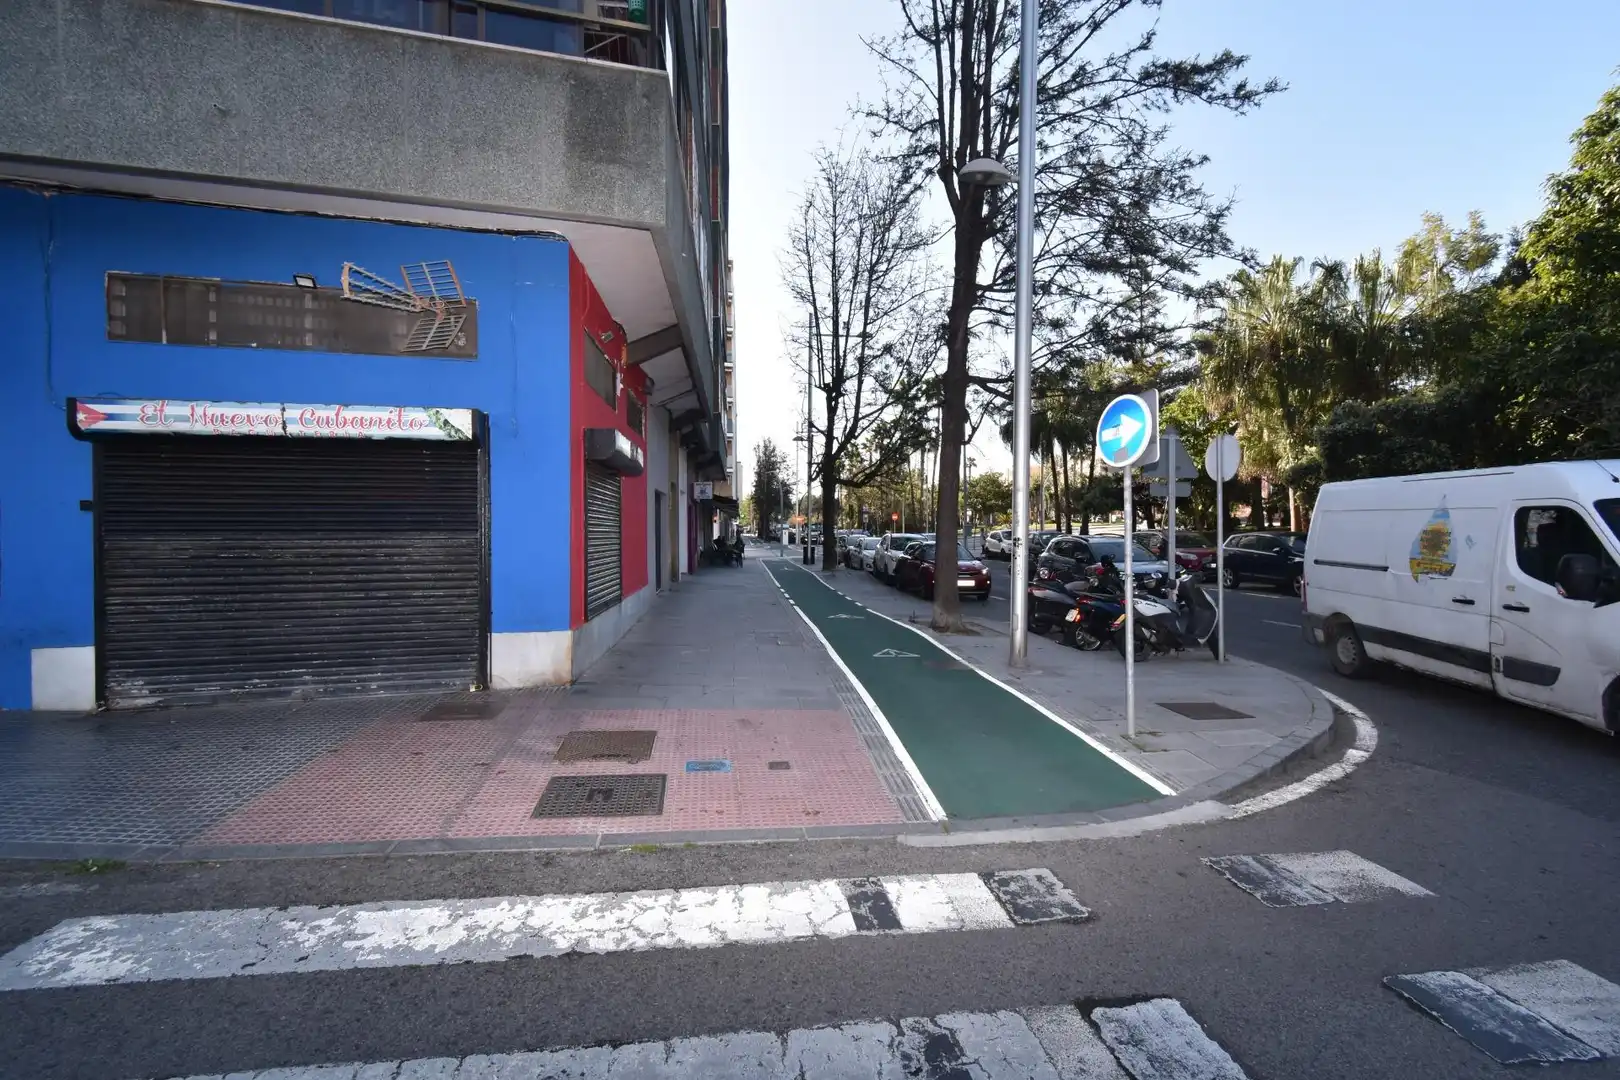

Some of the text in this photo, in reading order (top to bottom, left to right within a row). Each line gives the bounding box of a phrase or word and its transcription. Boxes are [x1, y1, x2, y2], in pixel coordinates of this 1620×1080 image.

[137, 400, 429, 431] El Nuevo Cubanito
